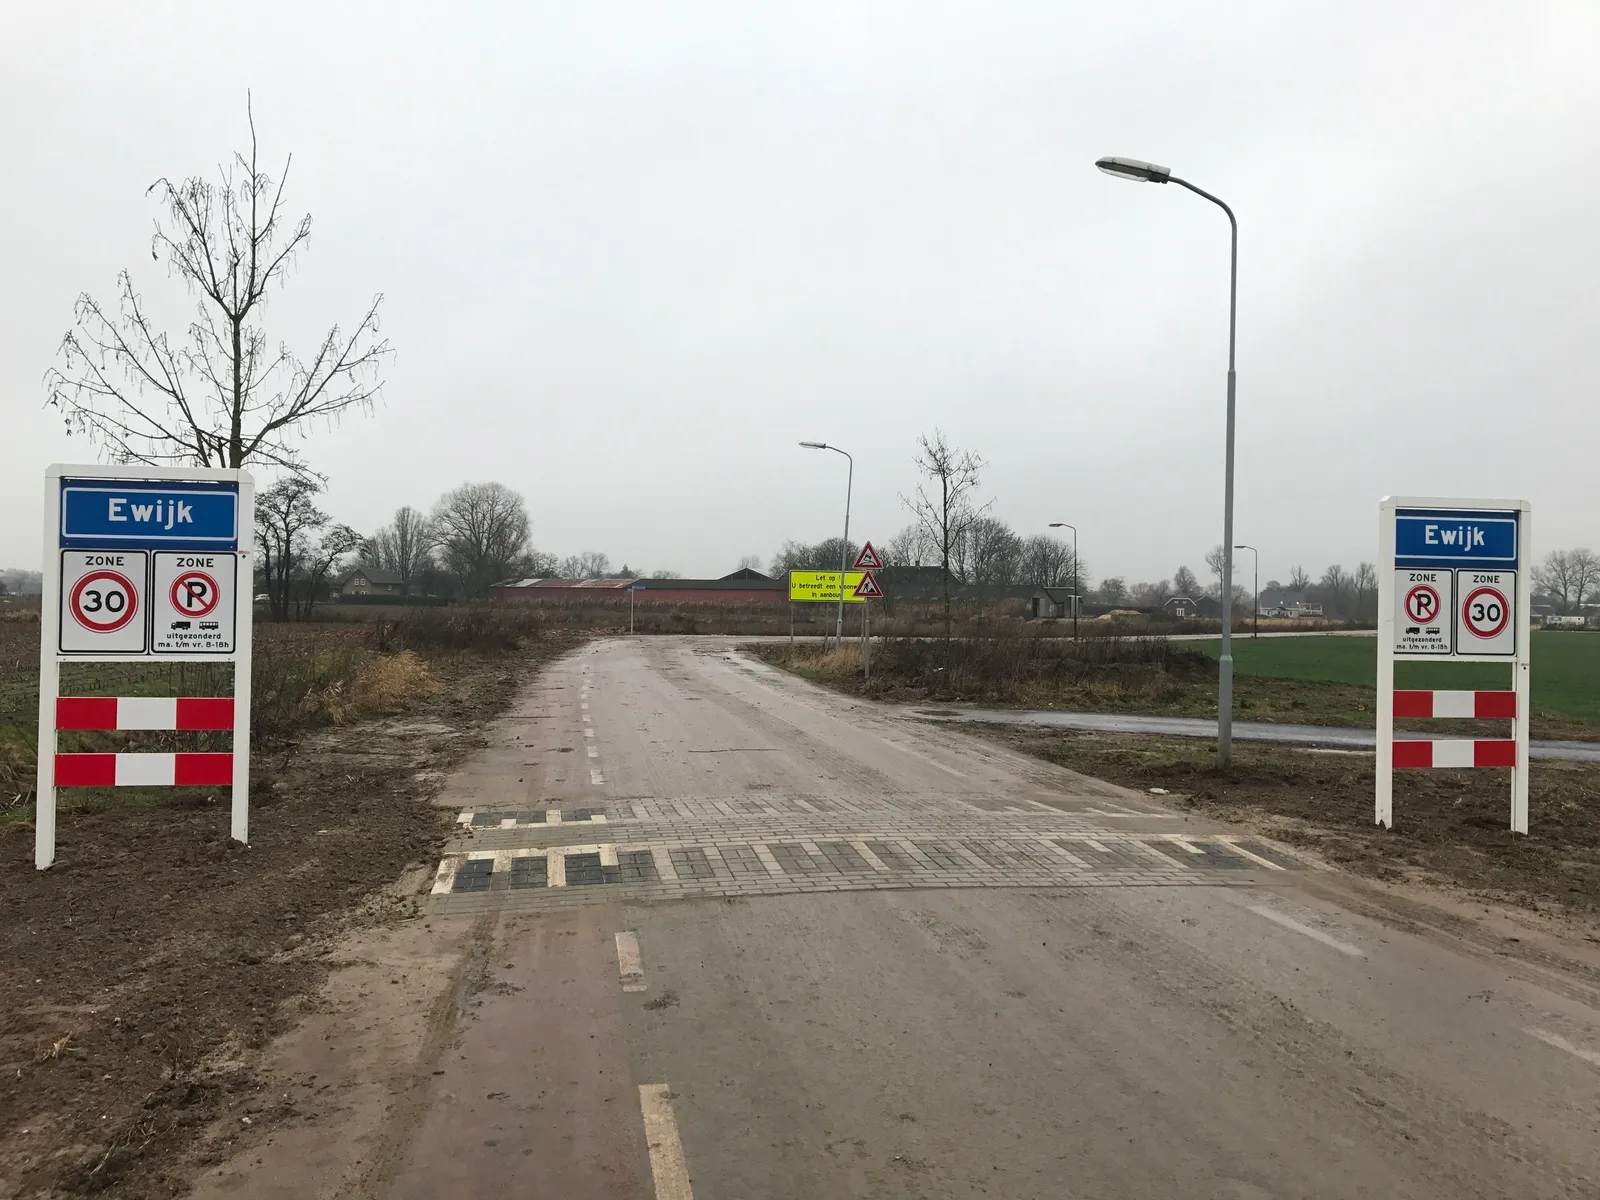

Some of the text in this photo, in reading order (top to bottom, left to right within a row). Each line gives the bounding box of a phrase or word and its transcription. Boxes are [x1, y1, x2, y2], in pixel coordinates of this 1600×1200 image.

[108, 497, 193, 530] Ewijk
[1425, 524, 1485, 552] Ewijk
[85, 555, 125, 566] ZONE
[176, 557, 214, 568] ZONE
[1409, 573, 1437, 582] ZONE
[1473, 575, 1500, 584] ZONE
[83, 590, 125, 613] 30
[1471, 603, 1501, 622] 30
[166, 632, 221, 641] uitgezonderd
